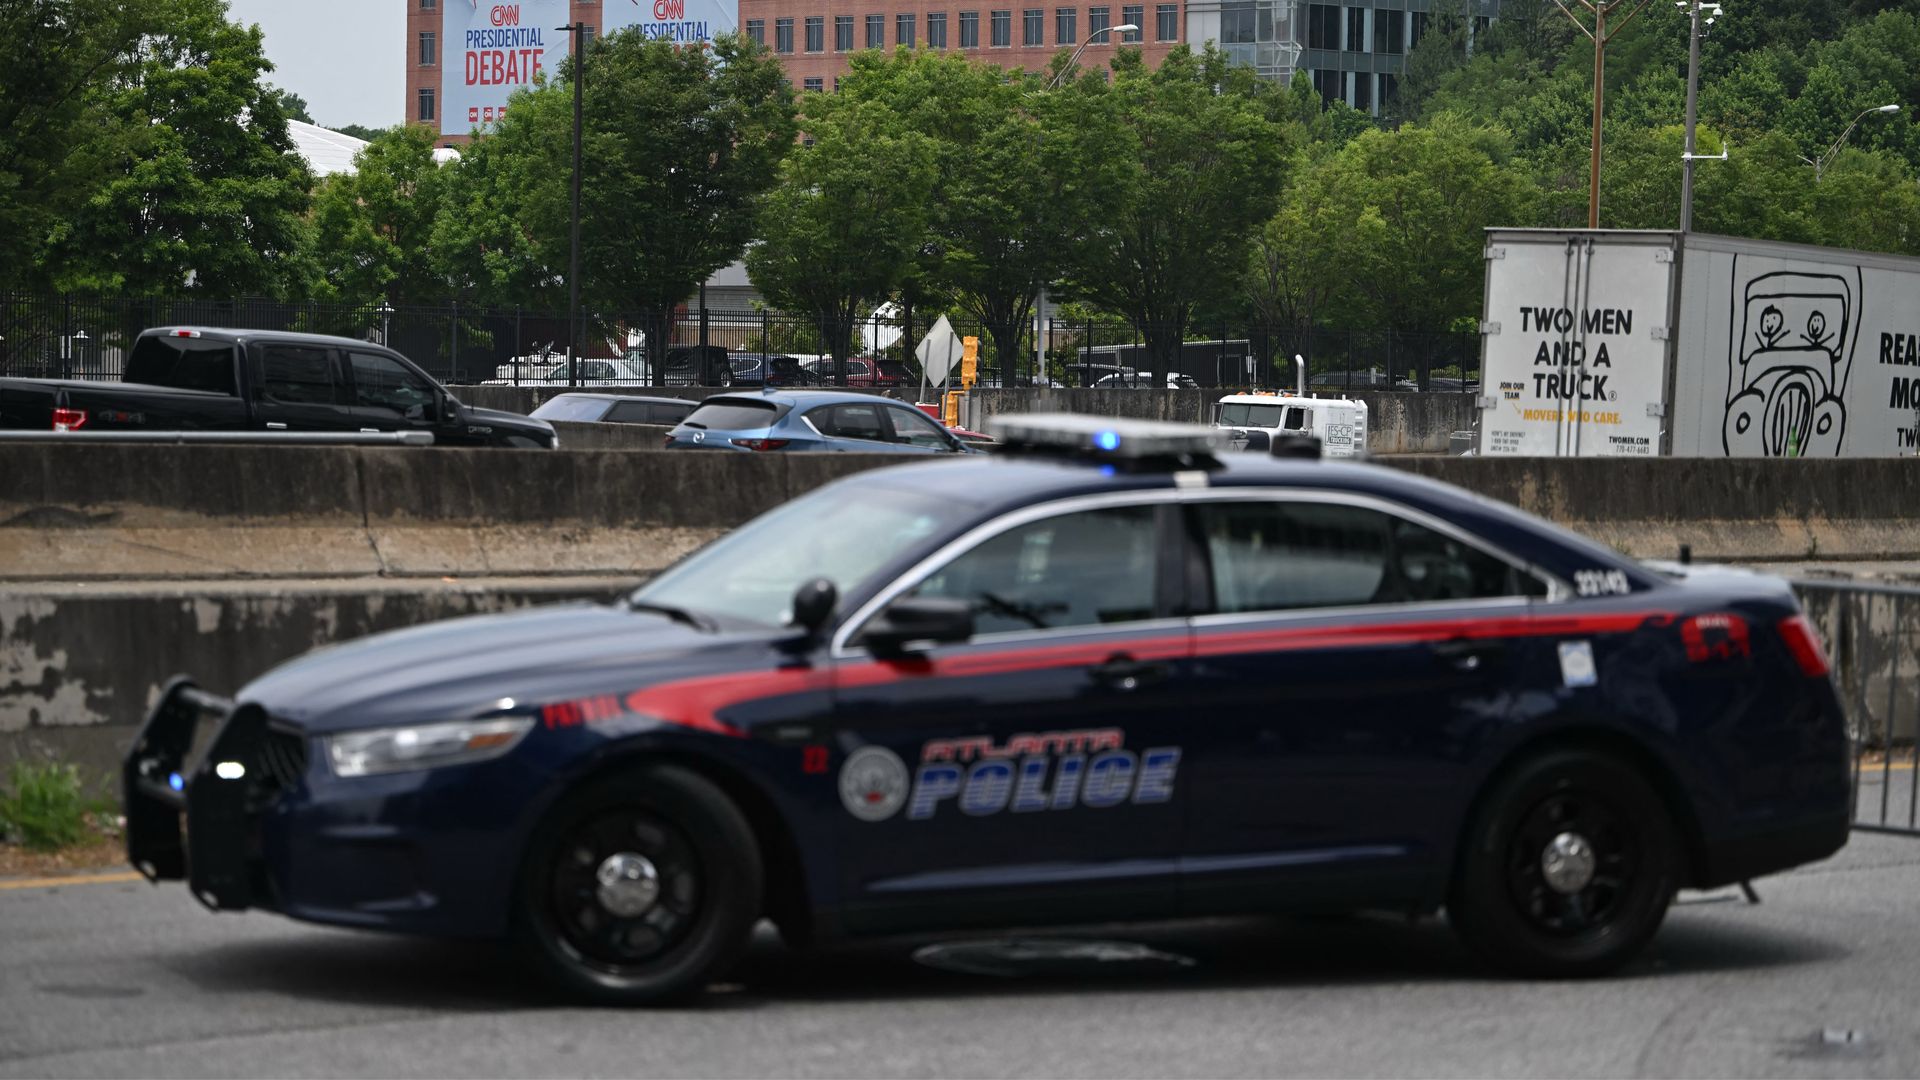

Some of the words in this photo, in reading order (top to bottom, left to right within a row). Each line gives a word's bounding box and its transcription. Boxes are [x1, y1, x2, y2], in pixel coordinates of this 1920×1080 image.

[490, 4, 520, 27] CNN
[653, 0, 684, 20] CNN
[466, 28, 545, 49] PRESIDENTIAL
[466, 49, 544, 85] DEBATE
[1519, 307, 1574, 334] TWO
[1580, 308, 1633, 335] MEN
[1533, 341, 1586, 367] AND
[1592, 342, 1611, 368] A
[1879, 332, 1920, 366] REA
[1499, 382, 1512, 390] JOIN
[1513, 382, 1525, 391] OUR
[1523, 409, 1564, 422] MOVERS
[1567, 410, 1590, 423] WHO
[1594, 411, 1622, 424] CARE.
[1609, 436, 1650, 445] TWOMEN.COM
[1897, 427, 1920, 447] TW
[919, 727, 1126, 762] ATLANTA
[906, 747, 1182, 820] POLICE
